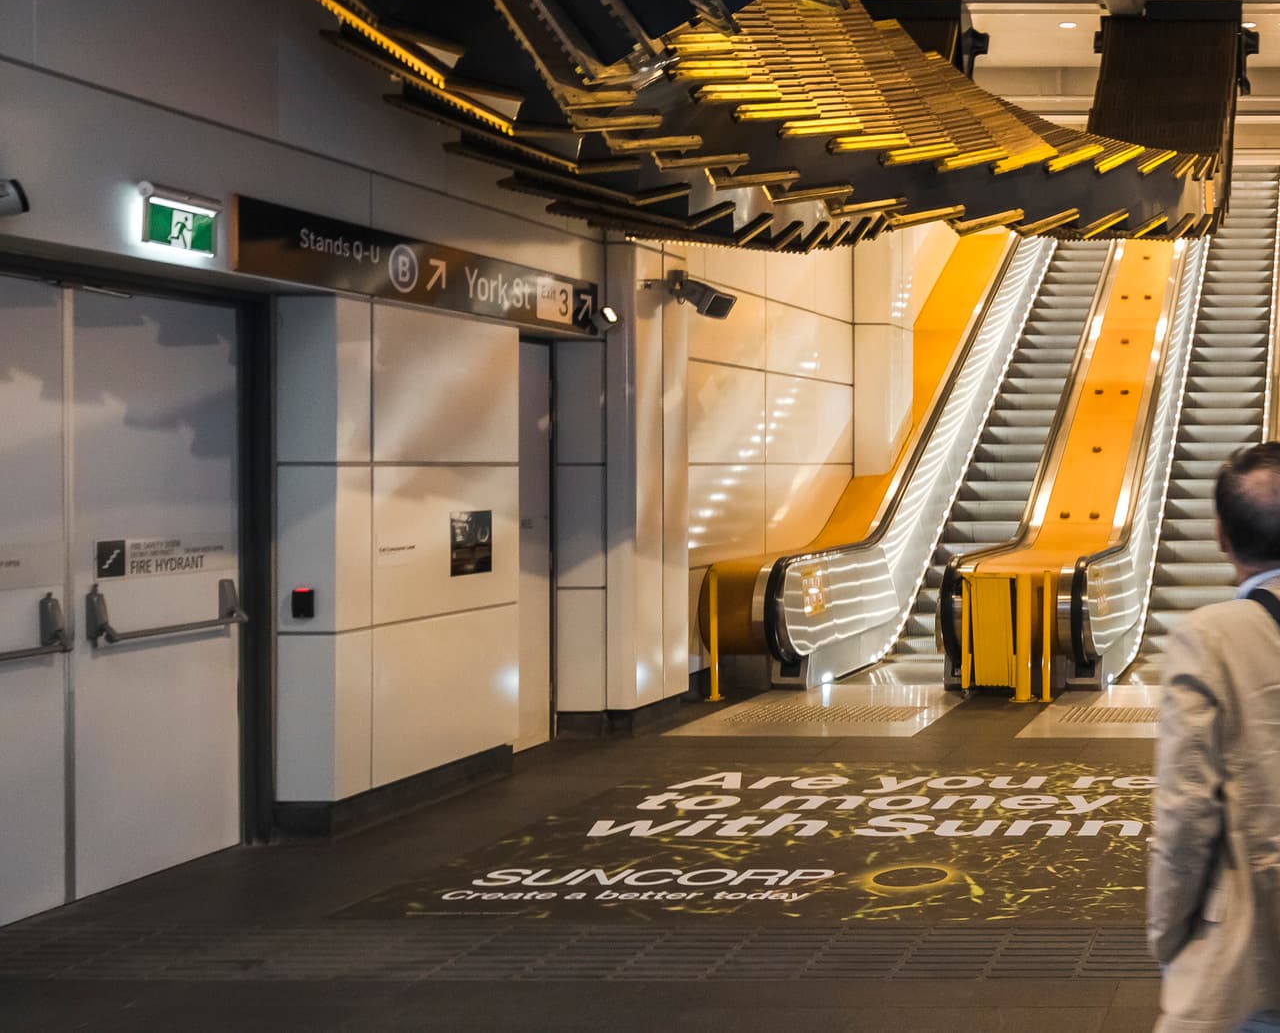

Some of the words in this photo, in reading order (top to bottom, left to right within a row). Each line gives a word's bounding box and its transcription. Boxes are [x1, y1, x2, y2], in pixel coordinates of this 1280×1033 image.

[300, 228, 350, 257] Stands
[353, 241, 380, 263] Q-U
[464, 266, 509, 306] York
[512, 277, 530, 310] St
[559, 288, 569, 317] 3
[130, 558, 152, 575] FIRE
[155, 555, 204, 572] HYDRANT
[666, 771, 849, 790] Are
[862, 776, 1048, 794] you
[1071, 776, 1160, 789] re
[636, 792, 741, 810] to
[760, 794, 1120, 815] money
[586, 813, 828, 837] with
[855, 814, 1156, 842] Sunn
[472, 868, 835, 887] SUNCORP
[441, 890, 558, 900] Create
[564, 892, 587, 900] a
[594, 889, 704, 900] better
[713, 890, 810, 902] today
